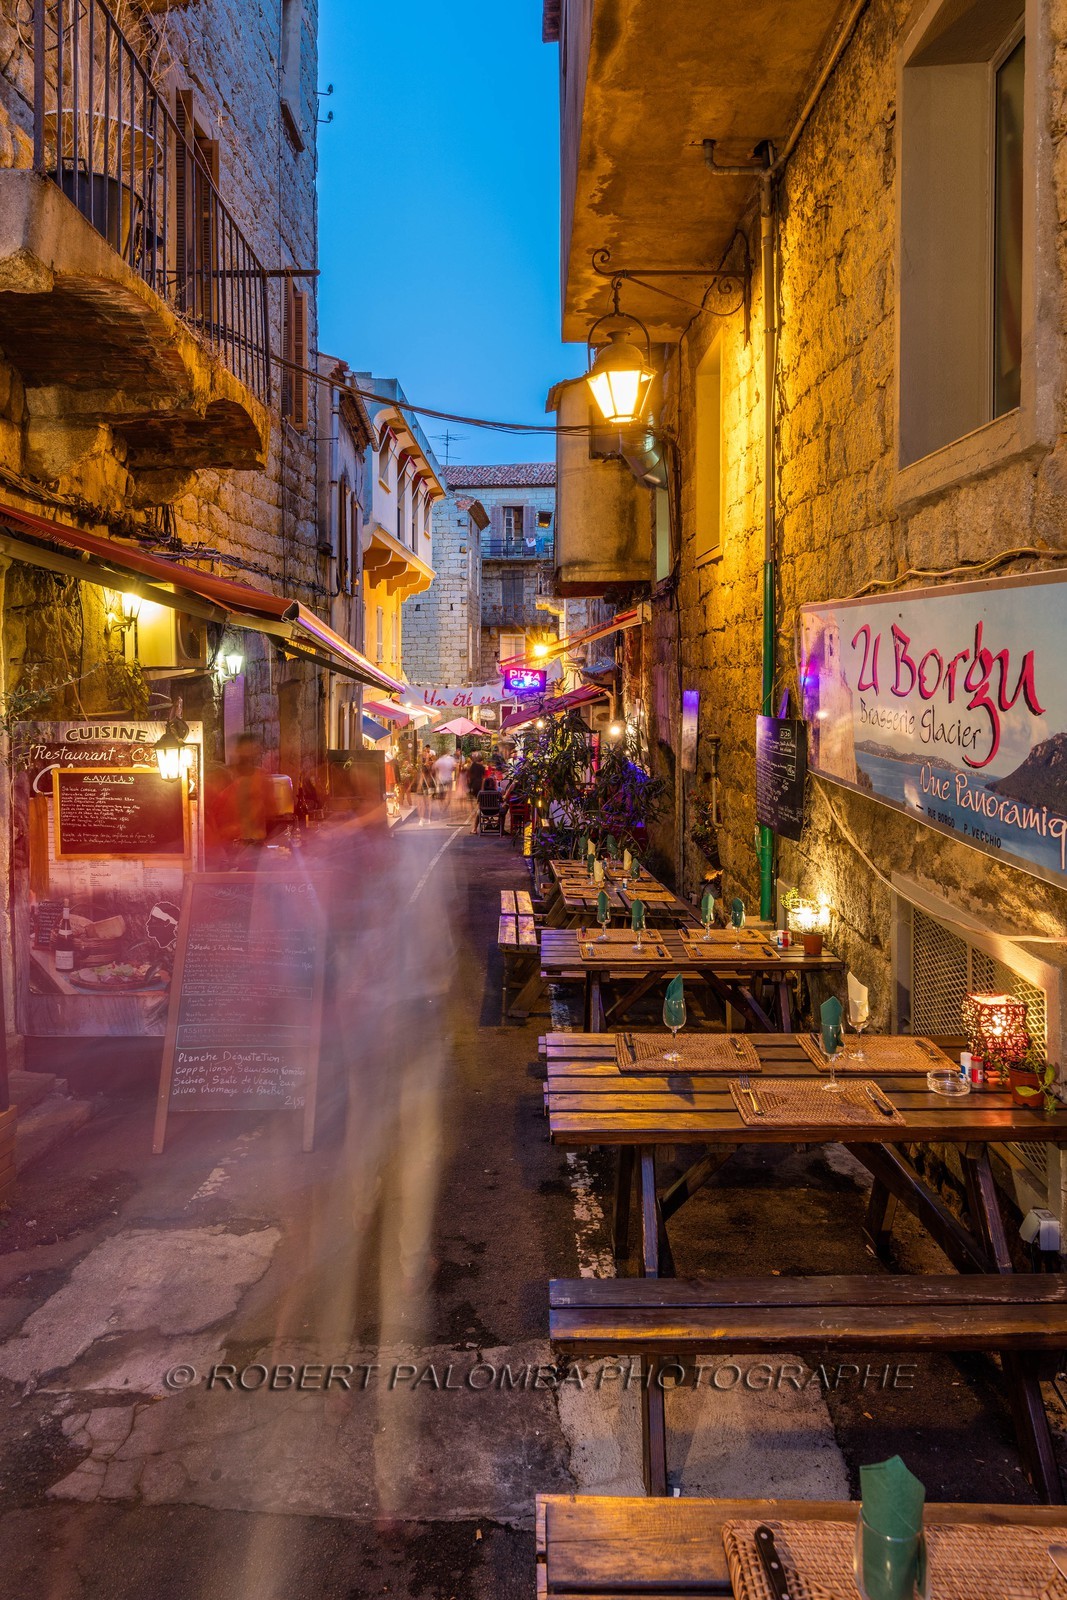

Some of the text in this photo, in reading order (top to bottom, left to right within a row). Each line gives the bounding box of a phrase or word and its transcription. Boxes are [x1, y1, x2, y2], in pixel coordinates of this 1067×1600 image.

[509, 669, 540, 680] PIZZA
[424, 689, 447, 706] Un
[452, 692, 473, 707] été
[851, 620, 1046, 768] U Borgu
[860, 697, 982, 750] Brasserie Glacier
[65, 725, 149, 743] CUISINE
[34, 745, 117, 761] Restaurant
[920, 762, 951, 800] Vue
[927, 807, 936, 820] RUE
[178, 1052, 218, 1063] Planche
